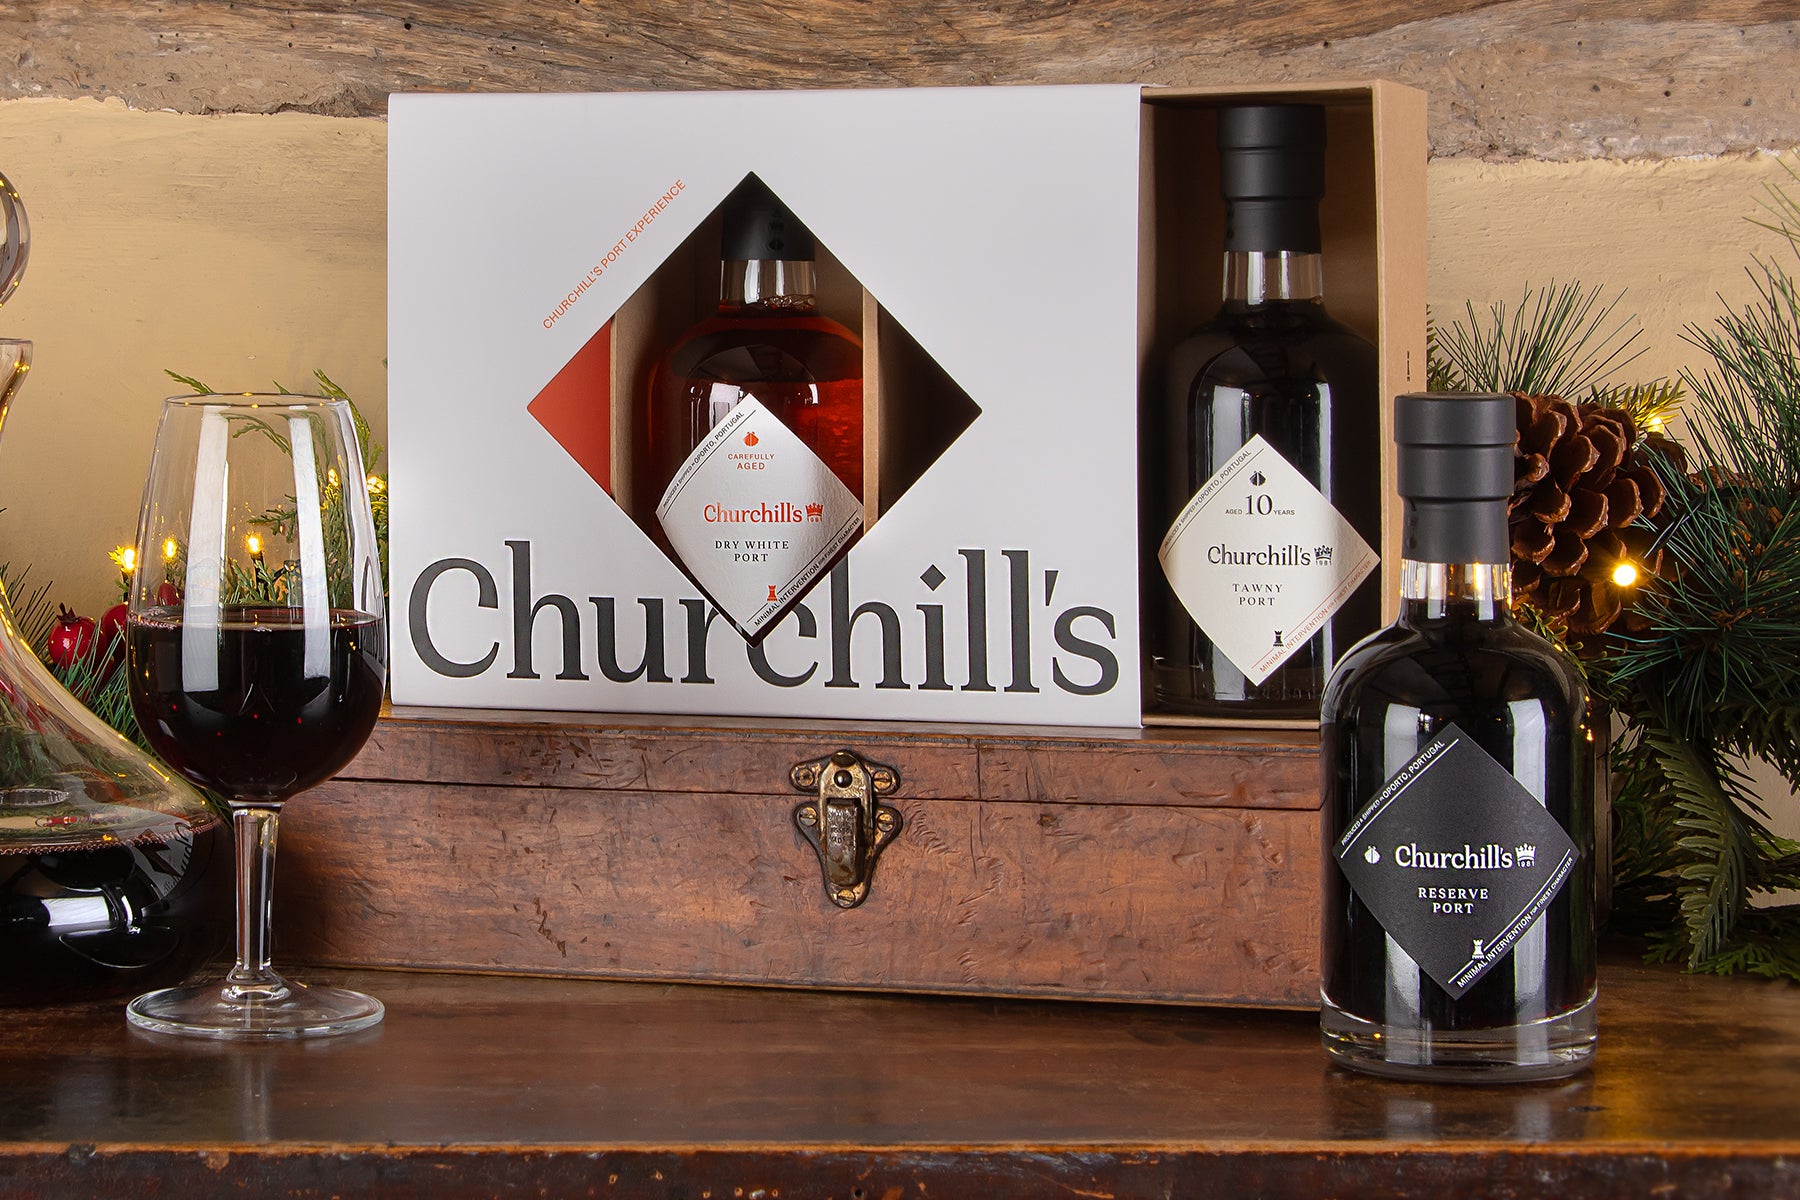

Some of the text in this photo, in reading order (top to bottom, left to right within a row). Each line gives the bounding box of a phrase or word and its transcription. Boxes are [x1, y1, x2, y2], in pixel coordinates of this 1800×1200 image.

[542, 178, 686, 329] CHURCHILL'S PORT EXPERIENCE
[693, 438, 717, 463] OPORTO,
[714, 410, 744, 440] PORTUGAL
[736, 462, 765, 470] AGED
[1196, 478, 1222, 503] OPORTO,
[1219, 449, 1251, 479] PORTUGAL
[703, 502, 803, 523] Churchill's
[1245, 494, 1273, 516] 10
[715, 540, 789, 550] DRY WHITE
[1207, 544, 1311, 566] Churchill's
[734, 553, 769, 562] PORT
[753, 601, 780, 626] MINIMAL
[777, 563, 820, 604] INTERVENTION
[1232, 584, 1283, 593] TAWNY
[1239, 597, 1275, 606] PORT
[408, 540, 1119, 697] Churchill's
[1258, 647, 1287, 673] MINIMAL
[1284, 607, 1328, 650] INTERVENTION
[1381, 769, 1412, 798] OPORTO,
[1408, 739, 1445, 773] PORTUGAL
[1395, 843, 1513, 869] Churchill's
[1418, 887, 1489, 899] RESERVE
[1433, 903, 1474, 914] PORT
[1456, 957, 1488, 988] MINIMAL
[1485, 913, 1532, 962] INTERVENTION
[1536, 887, 1553, 907] FINEST
[1550, 857, 1573, 889] CHARACTER
